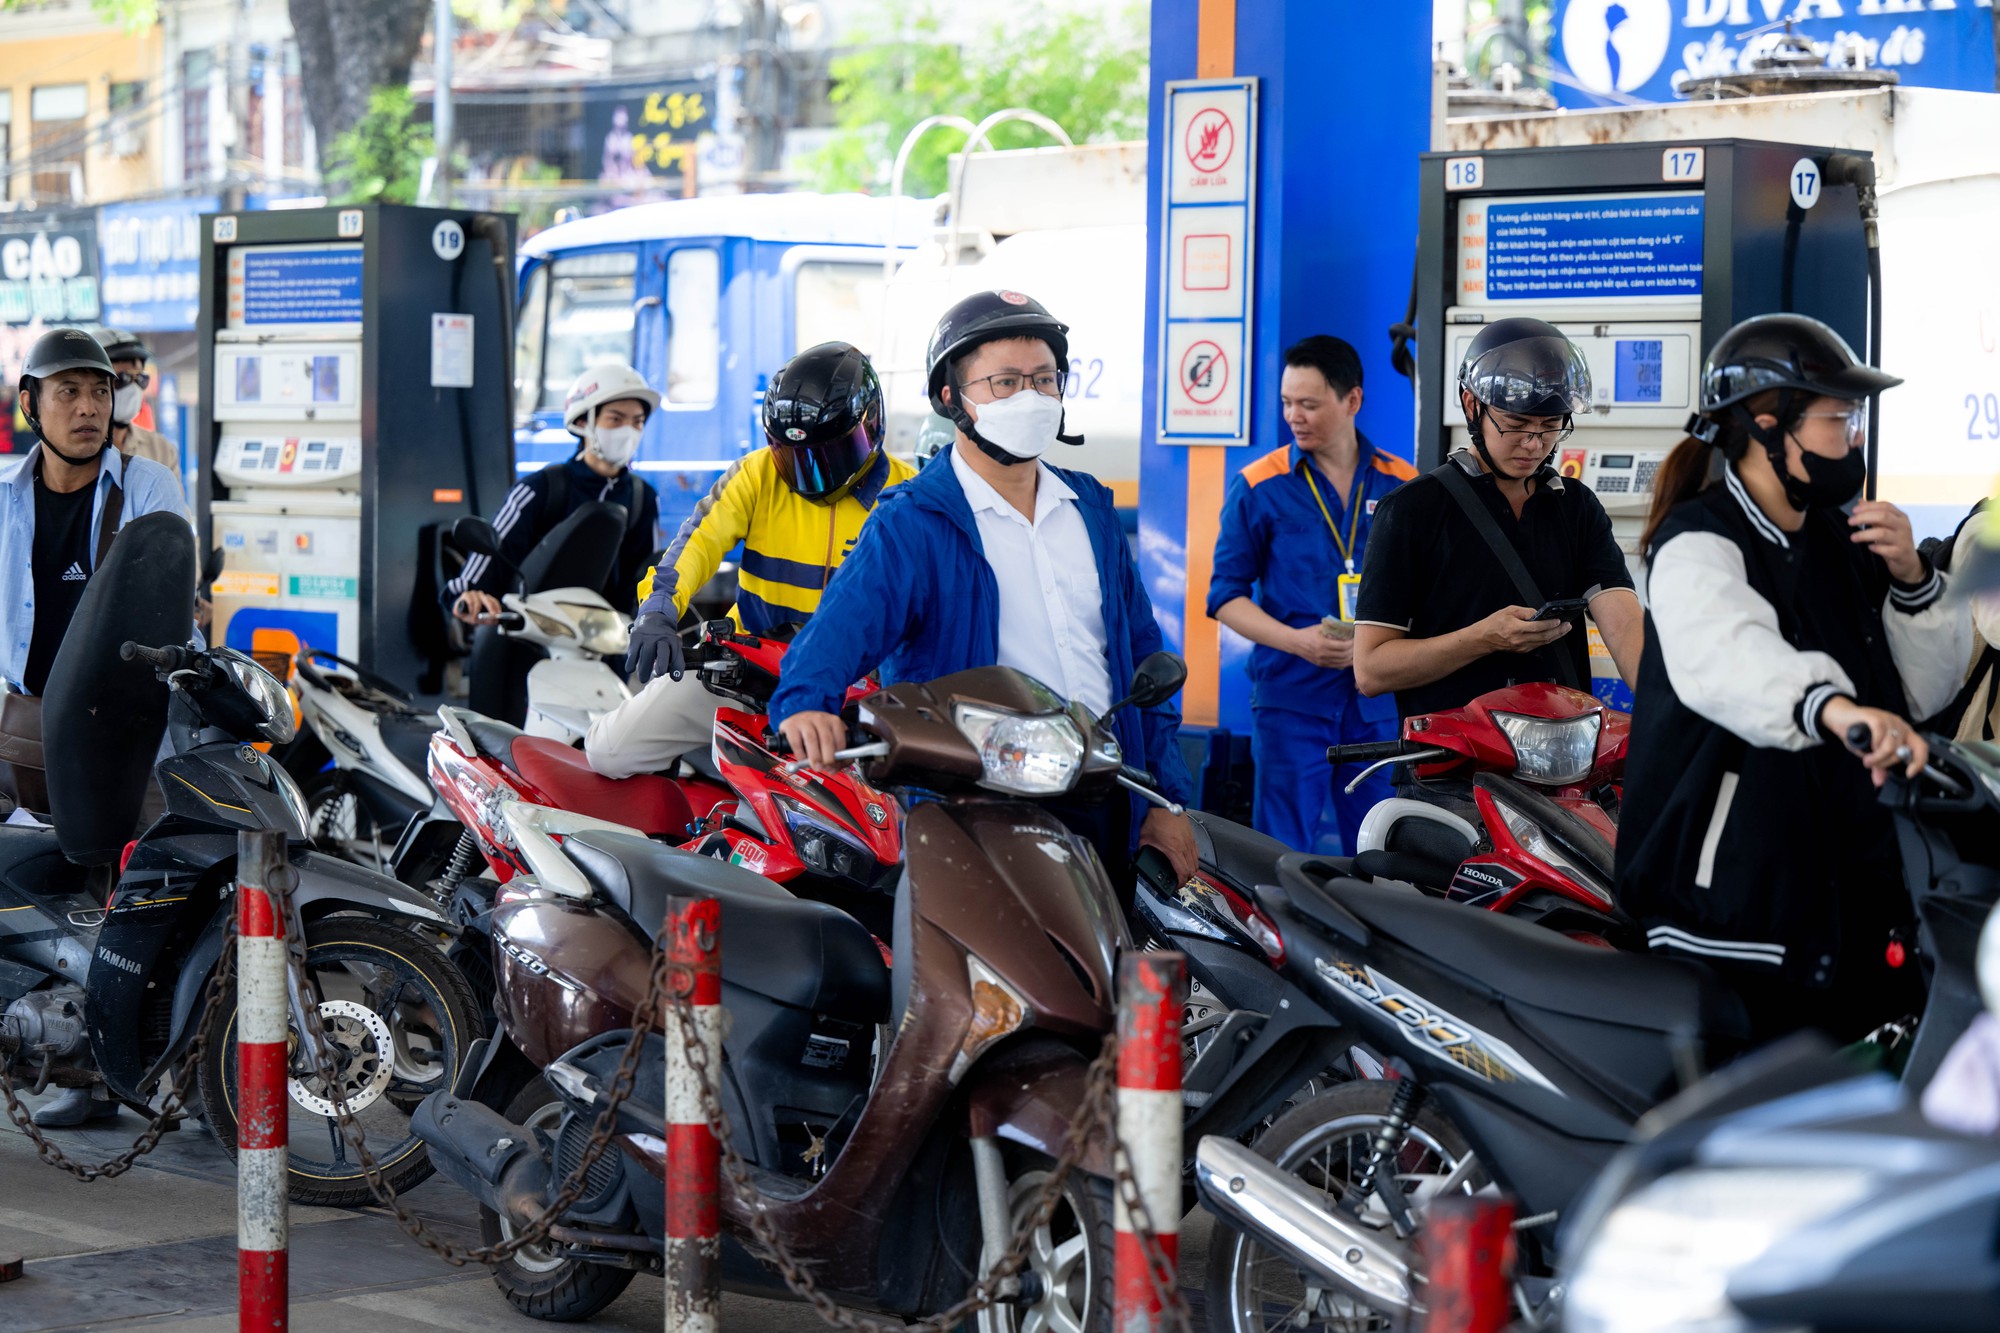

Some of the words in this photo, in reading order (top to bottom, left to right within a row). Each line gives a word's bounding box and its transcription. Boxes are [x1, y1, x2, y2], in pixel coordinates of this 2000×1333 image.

[1452, 162, 1477, 185] 18
[1669, 152, 1696, 176] 17
[1796, 172, 1816, 196] 17
[217, 220, 234, 239] 20
[342, 214, 359, 232] 19
[438, 229, 459, 250] 19
[1964, 392, 2000, 441] 29
[737, 839, 765, 863] agv
[1462, 866, 1505, 888] HONDA
[98, 945, 143, 976] YAMAHA
